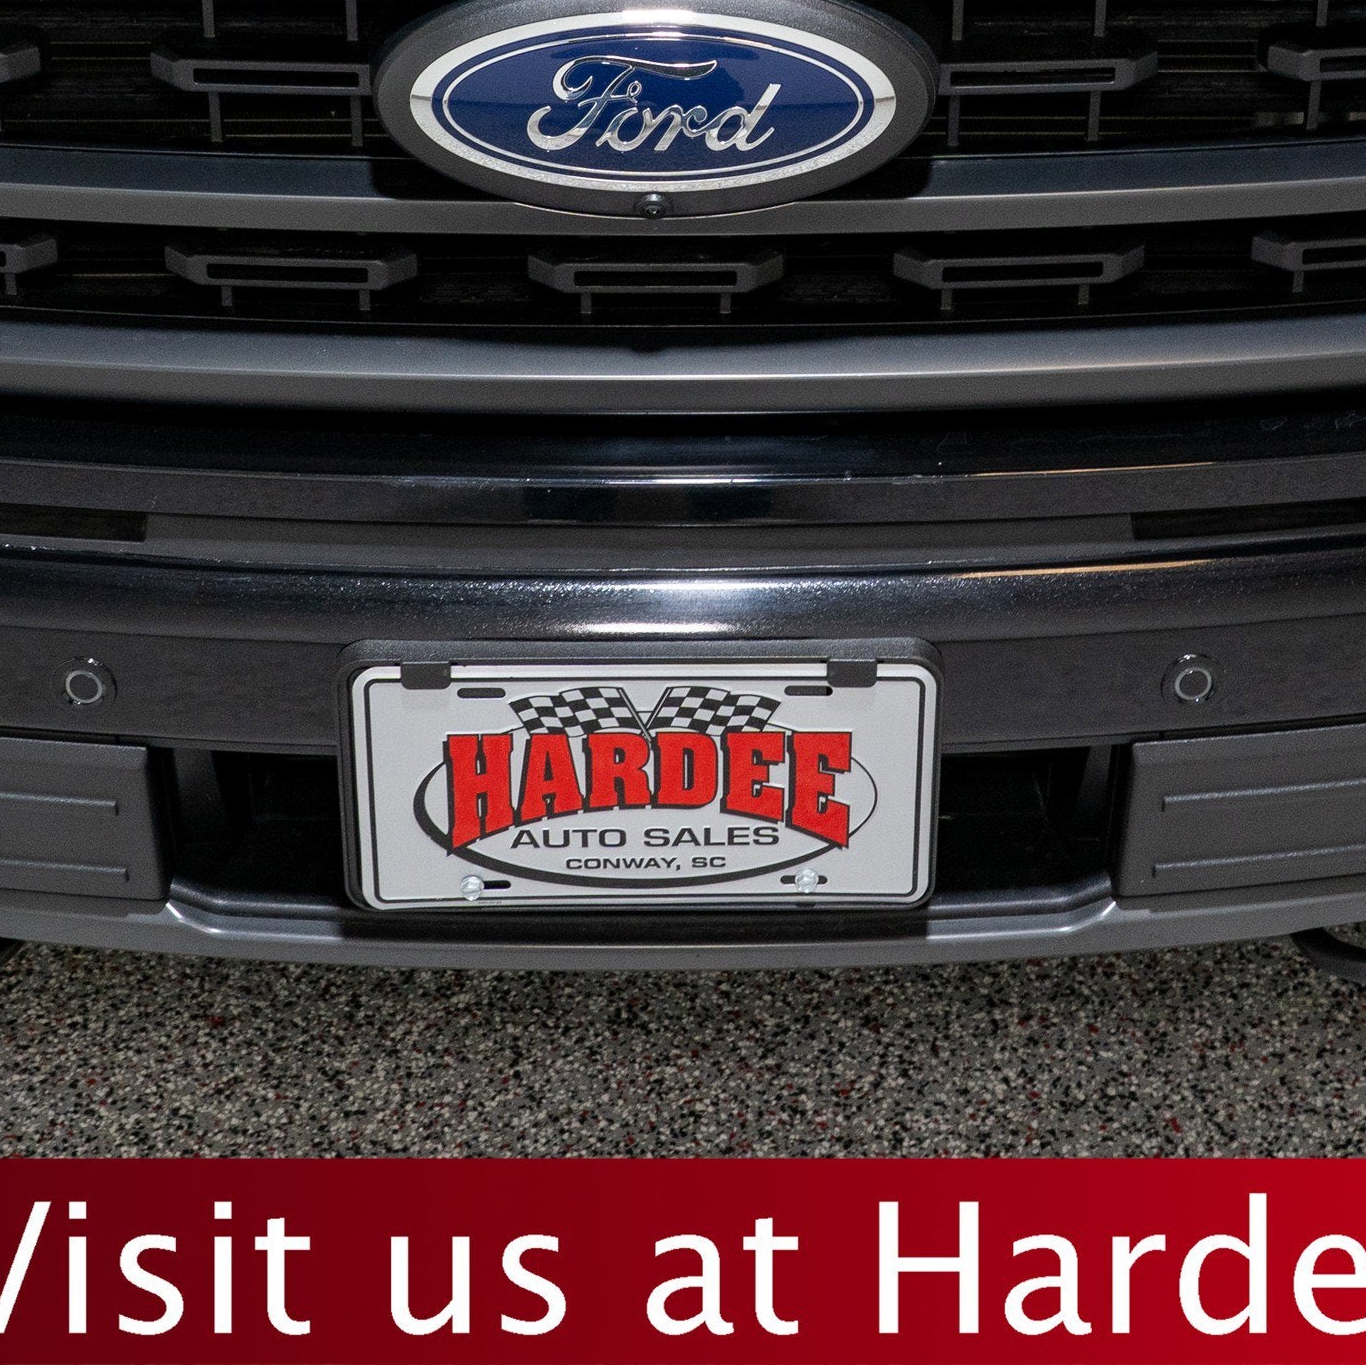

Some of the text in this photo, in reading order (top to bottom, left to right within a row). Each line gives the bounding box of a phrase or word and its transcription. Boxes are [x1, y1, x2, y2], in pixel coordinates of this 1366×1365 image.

[527, 55, 781, 152] Ford
[442, 731, 852, 856] HARDEE
[510, 825, 780, 849] AUTO SALES
[565, 855, 727, 871] CONWAY, SC
